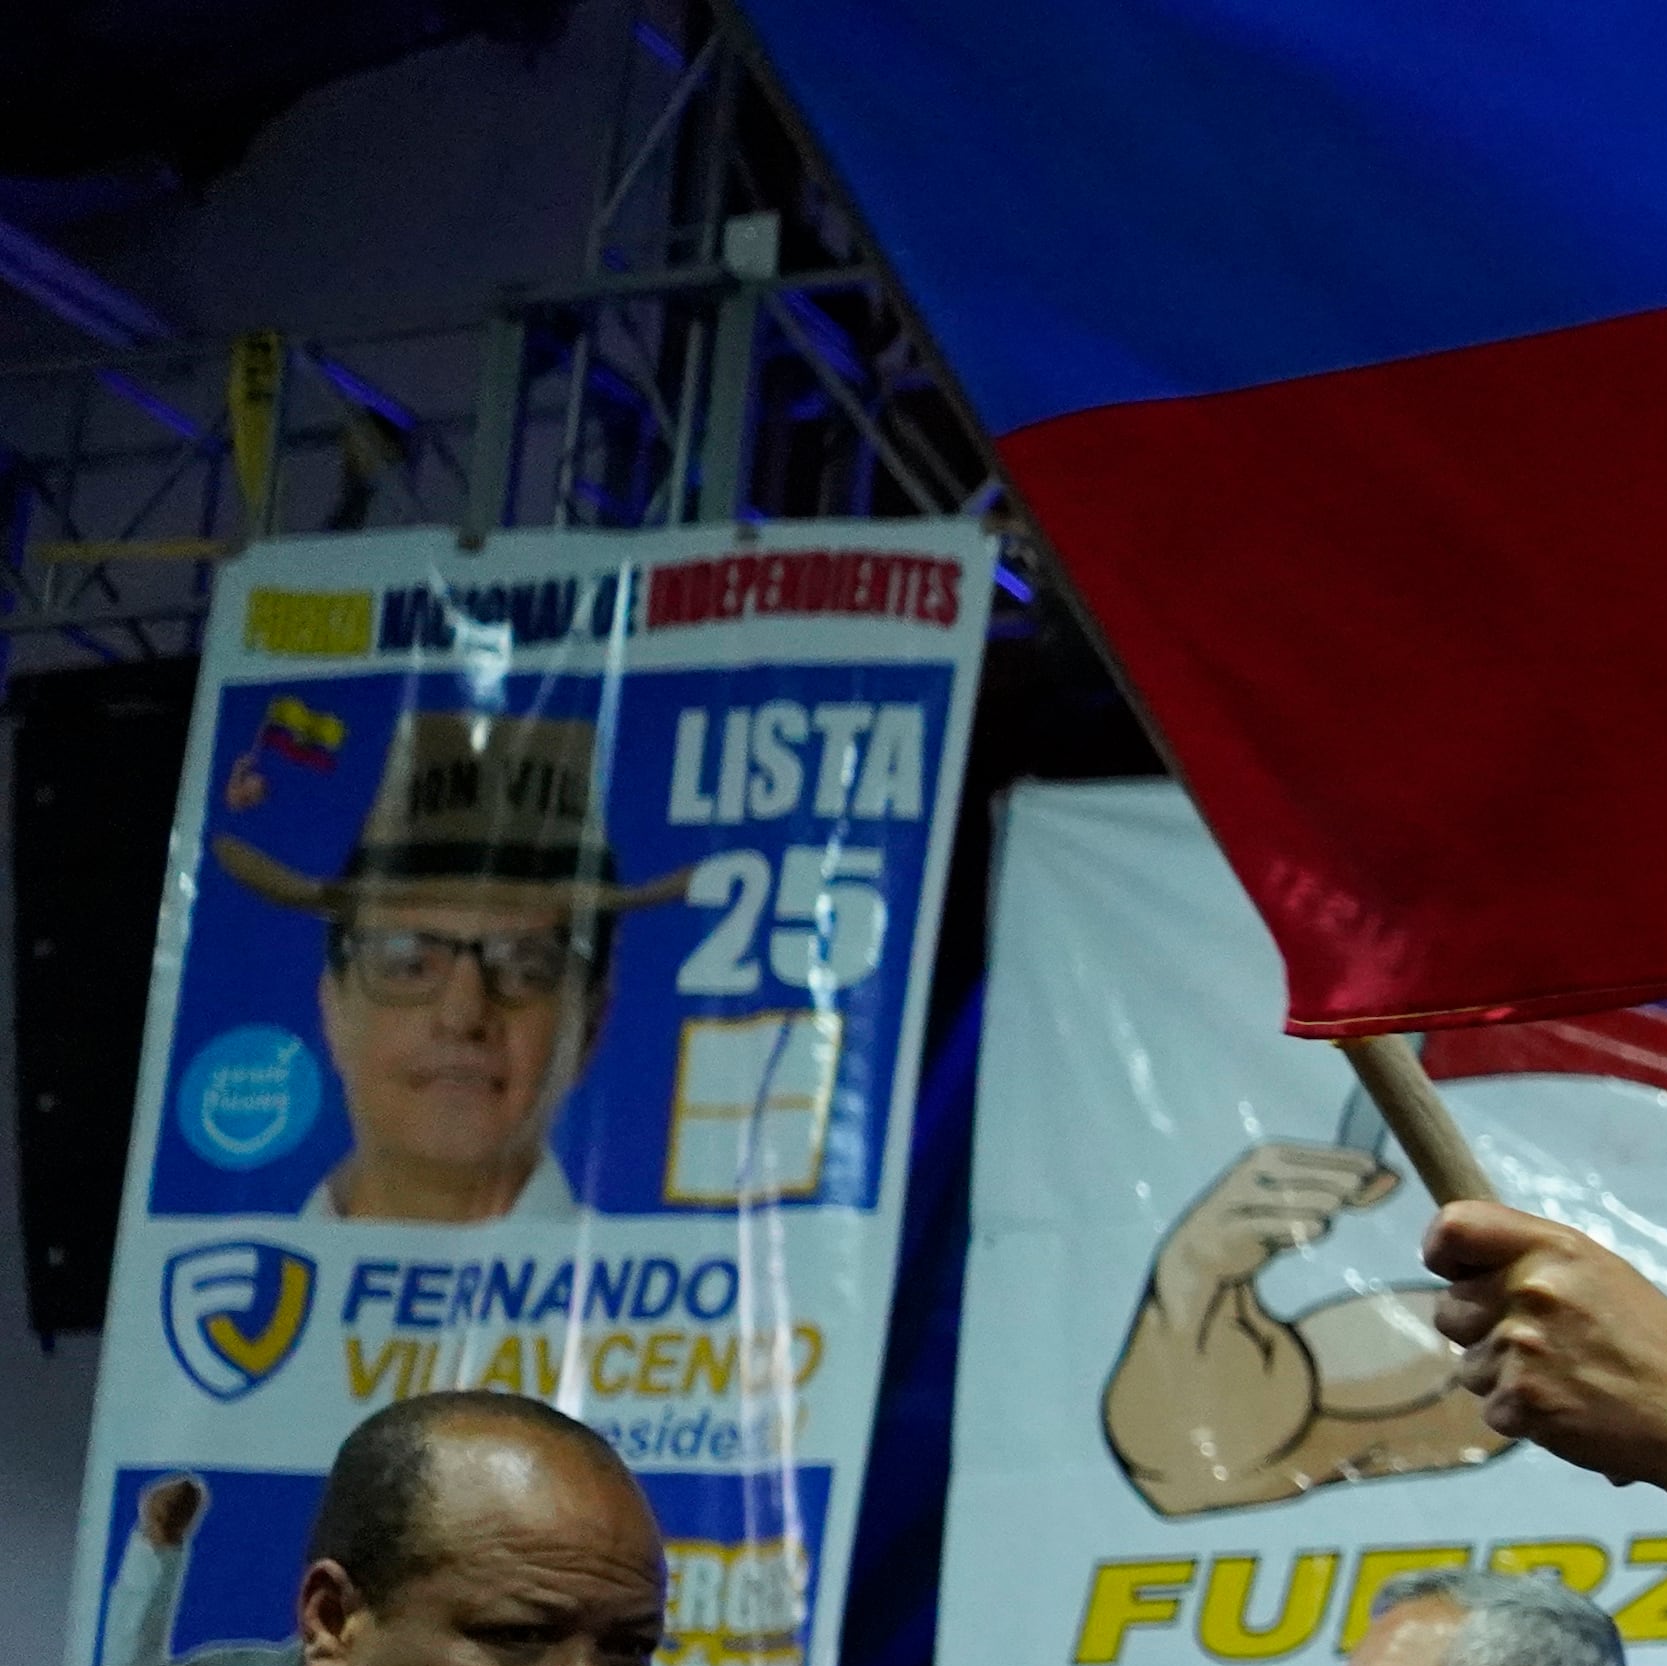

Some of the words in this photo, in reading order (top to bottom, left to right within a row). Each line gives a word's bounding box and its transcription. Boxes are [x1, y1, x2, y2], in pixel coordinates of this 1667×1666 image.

[667, 701, 924, 826] LISTA
[676, 843, 887, 997] 25
[342, 1258, 741, 1328] FERNANDO
